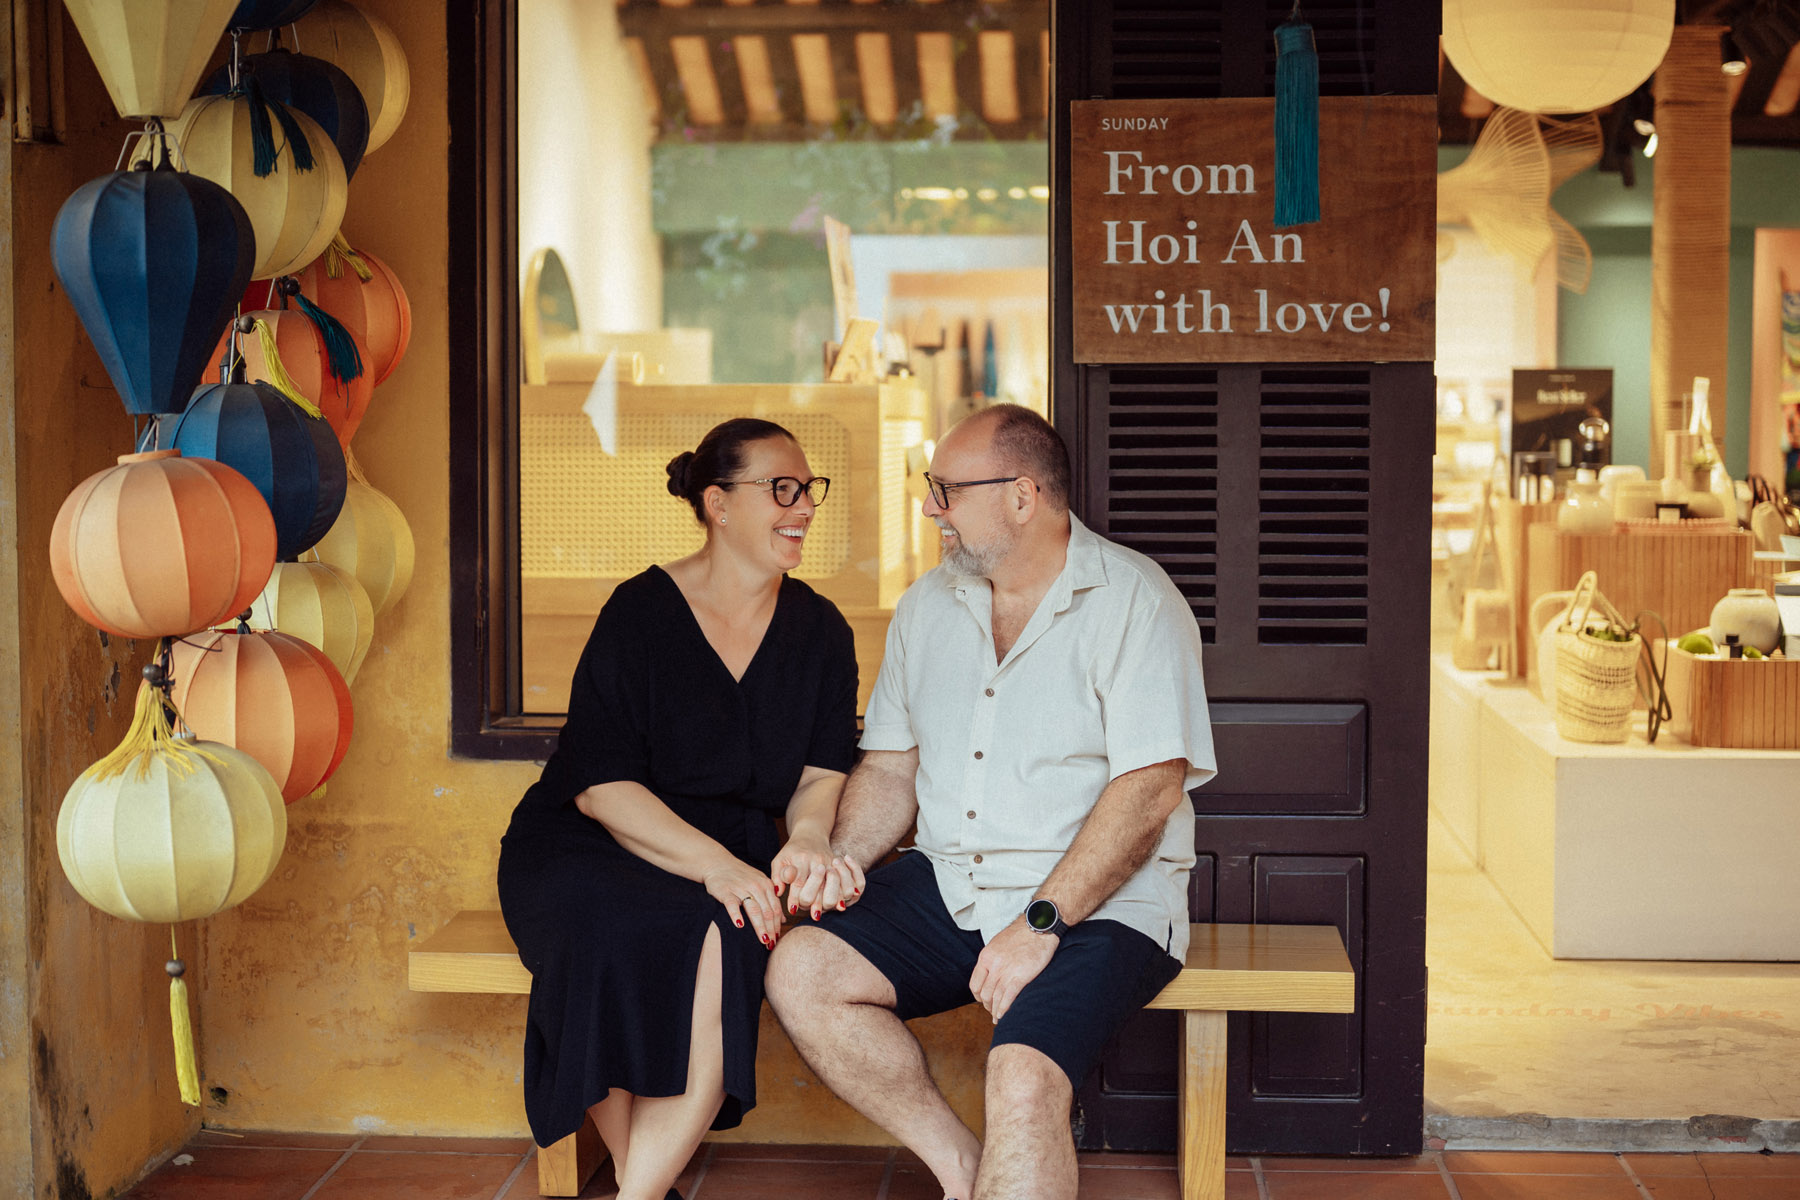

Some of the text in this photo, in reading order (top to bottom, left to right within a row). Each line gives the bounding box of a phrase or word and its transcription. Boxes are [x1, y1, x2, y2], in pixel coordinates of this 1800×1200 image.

[1102, 117, 1169, 131] SUNDAY
[1103, 151, 1257, 195] From
[1102, 219, 1305, 265] Hoi An
[1103, 287, 1391, 334] with love!
